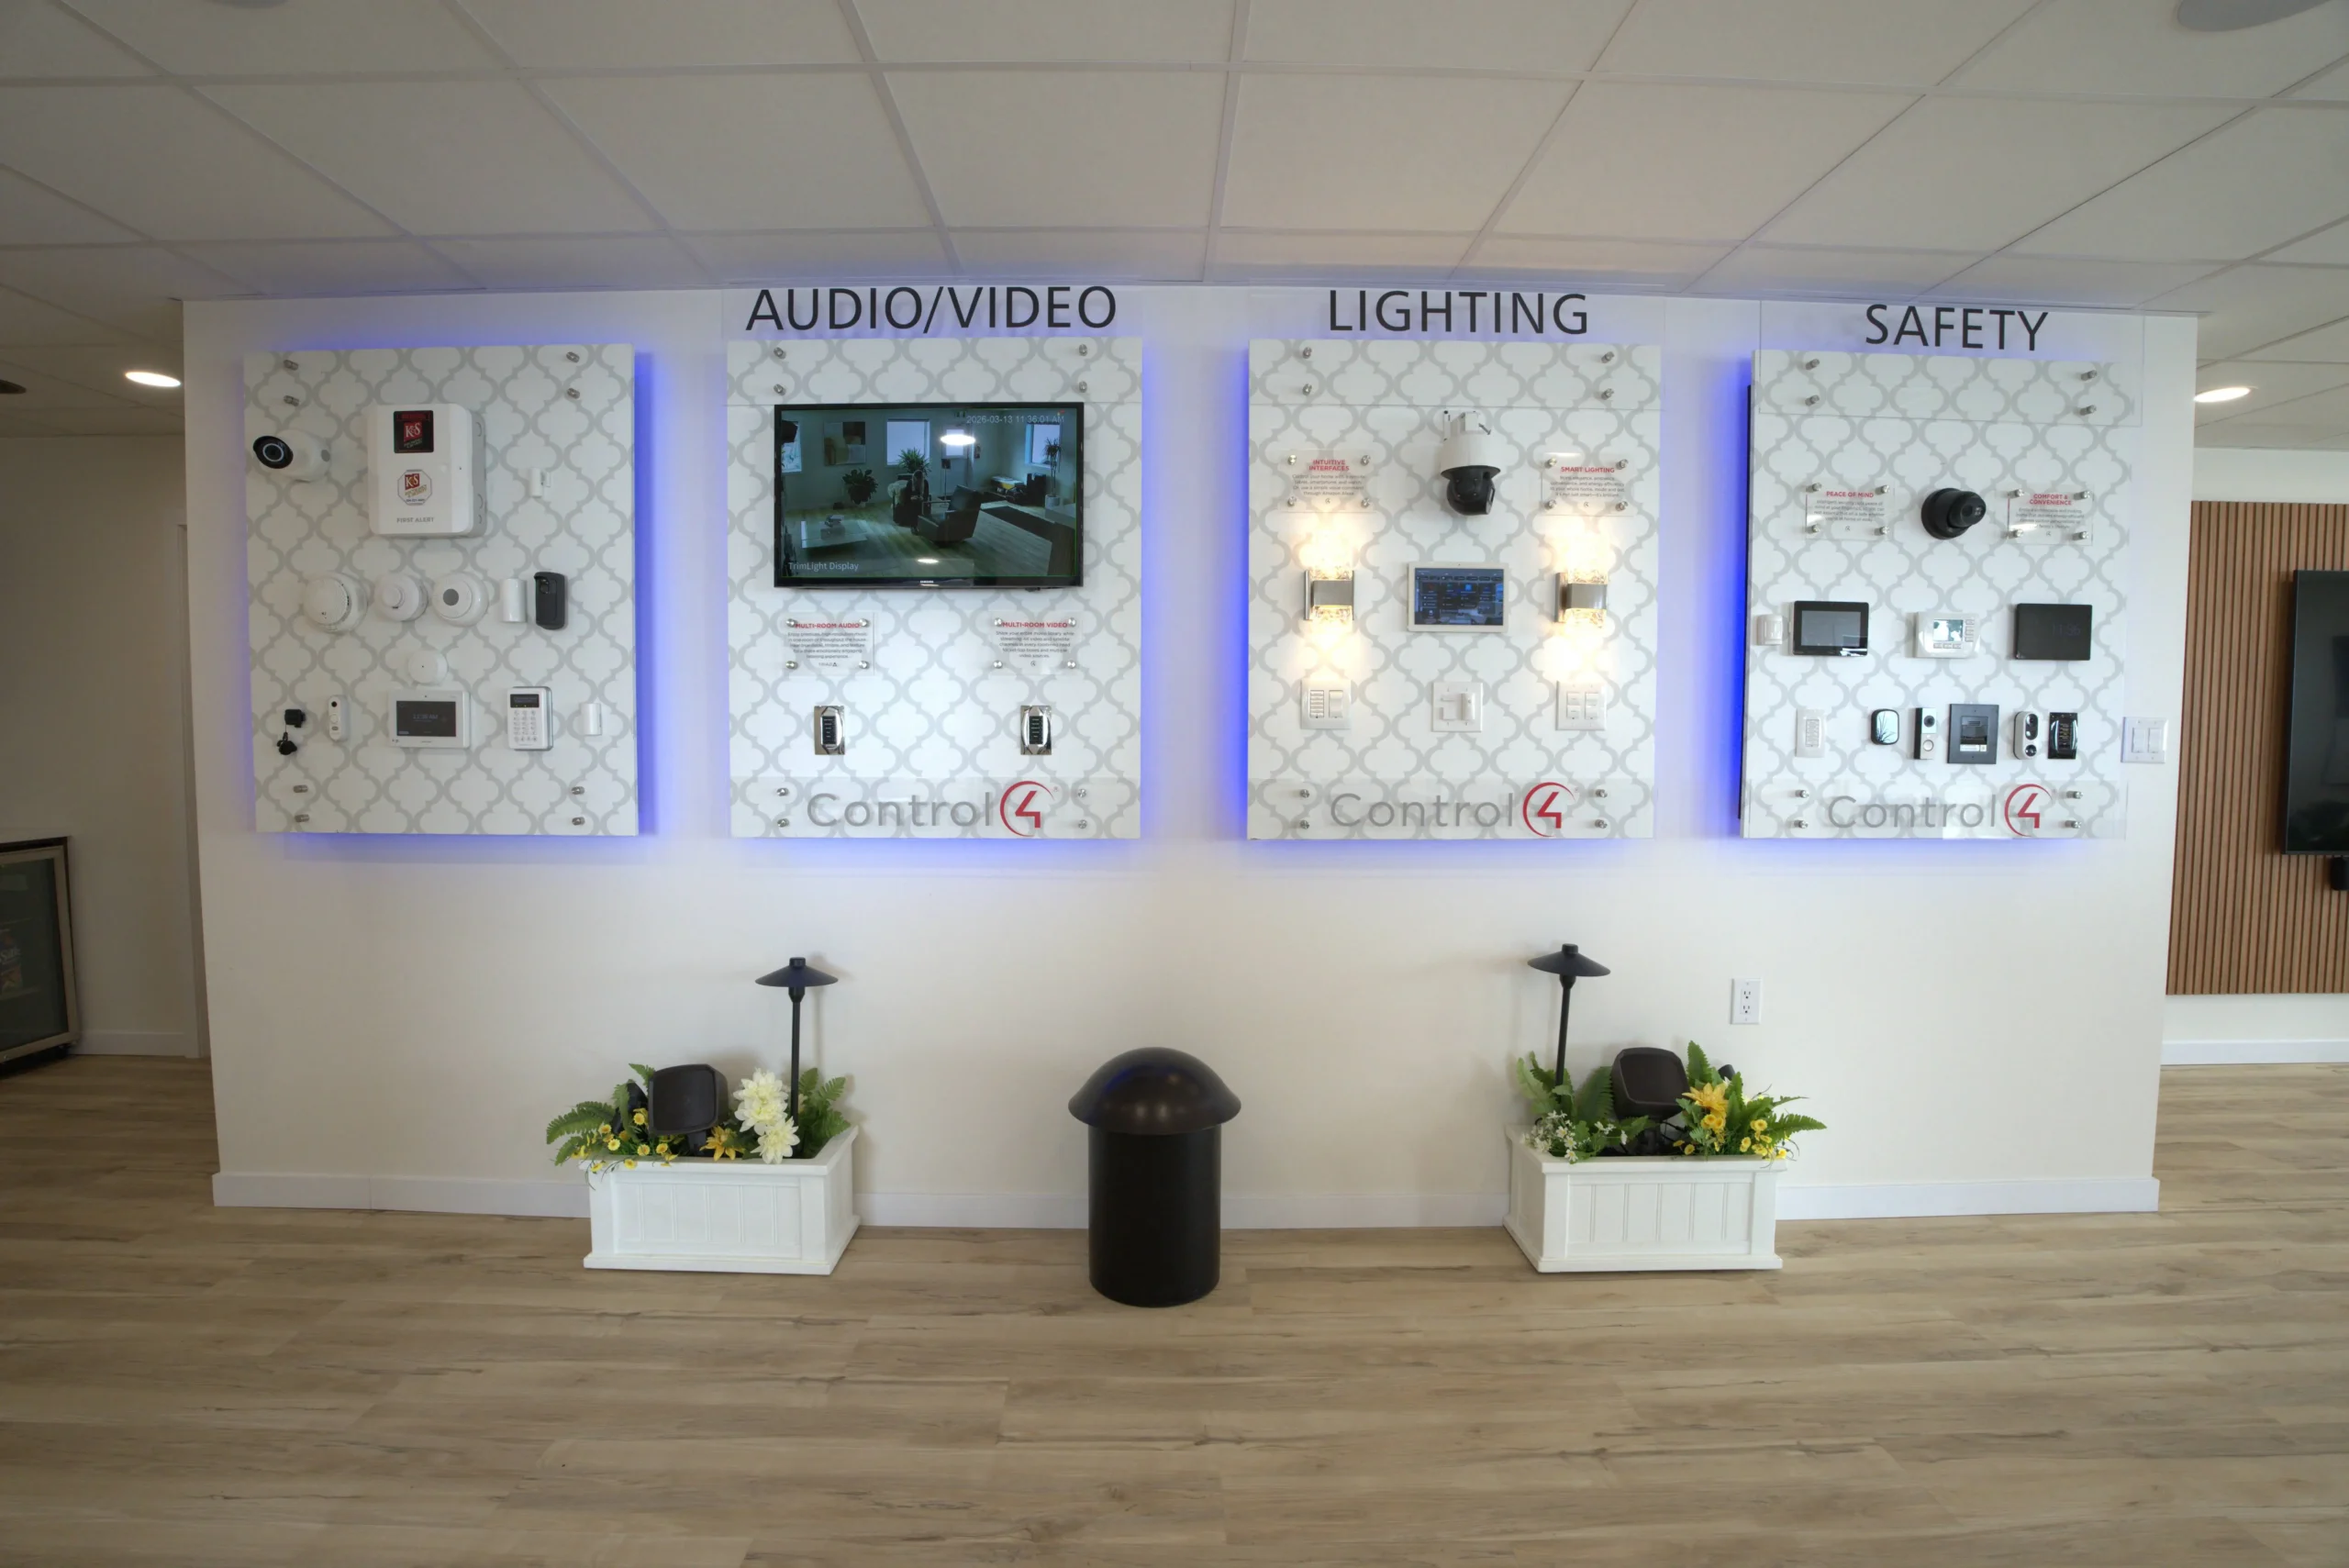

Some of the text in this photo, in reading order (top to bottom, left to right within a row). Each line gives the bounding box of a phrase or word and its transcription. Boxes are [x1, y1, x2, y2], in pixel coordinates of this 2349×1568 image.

[745, 285, 1117, 334] AUDIO/VIDEO
[1330, 290, 1587, 335] LIGHTING
[1865, 304, 2049, 350] SAFETY
[405, 422, 421, 438] K&S
[966, 416, 1013, 424] 2026-03-13
[1052, 415, 1064, 423] AM
[788, 562, 859, 572] TrimLight Display
